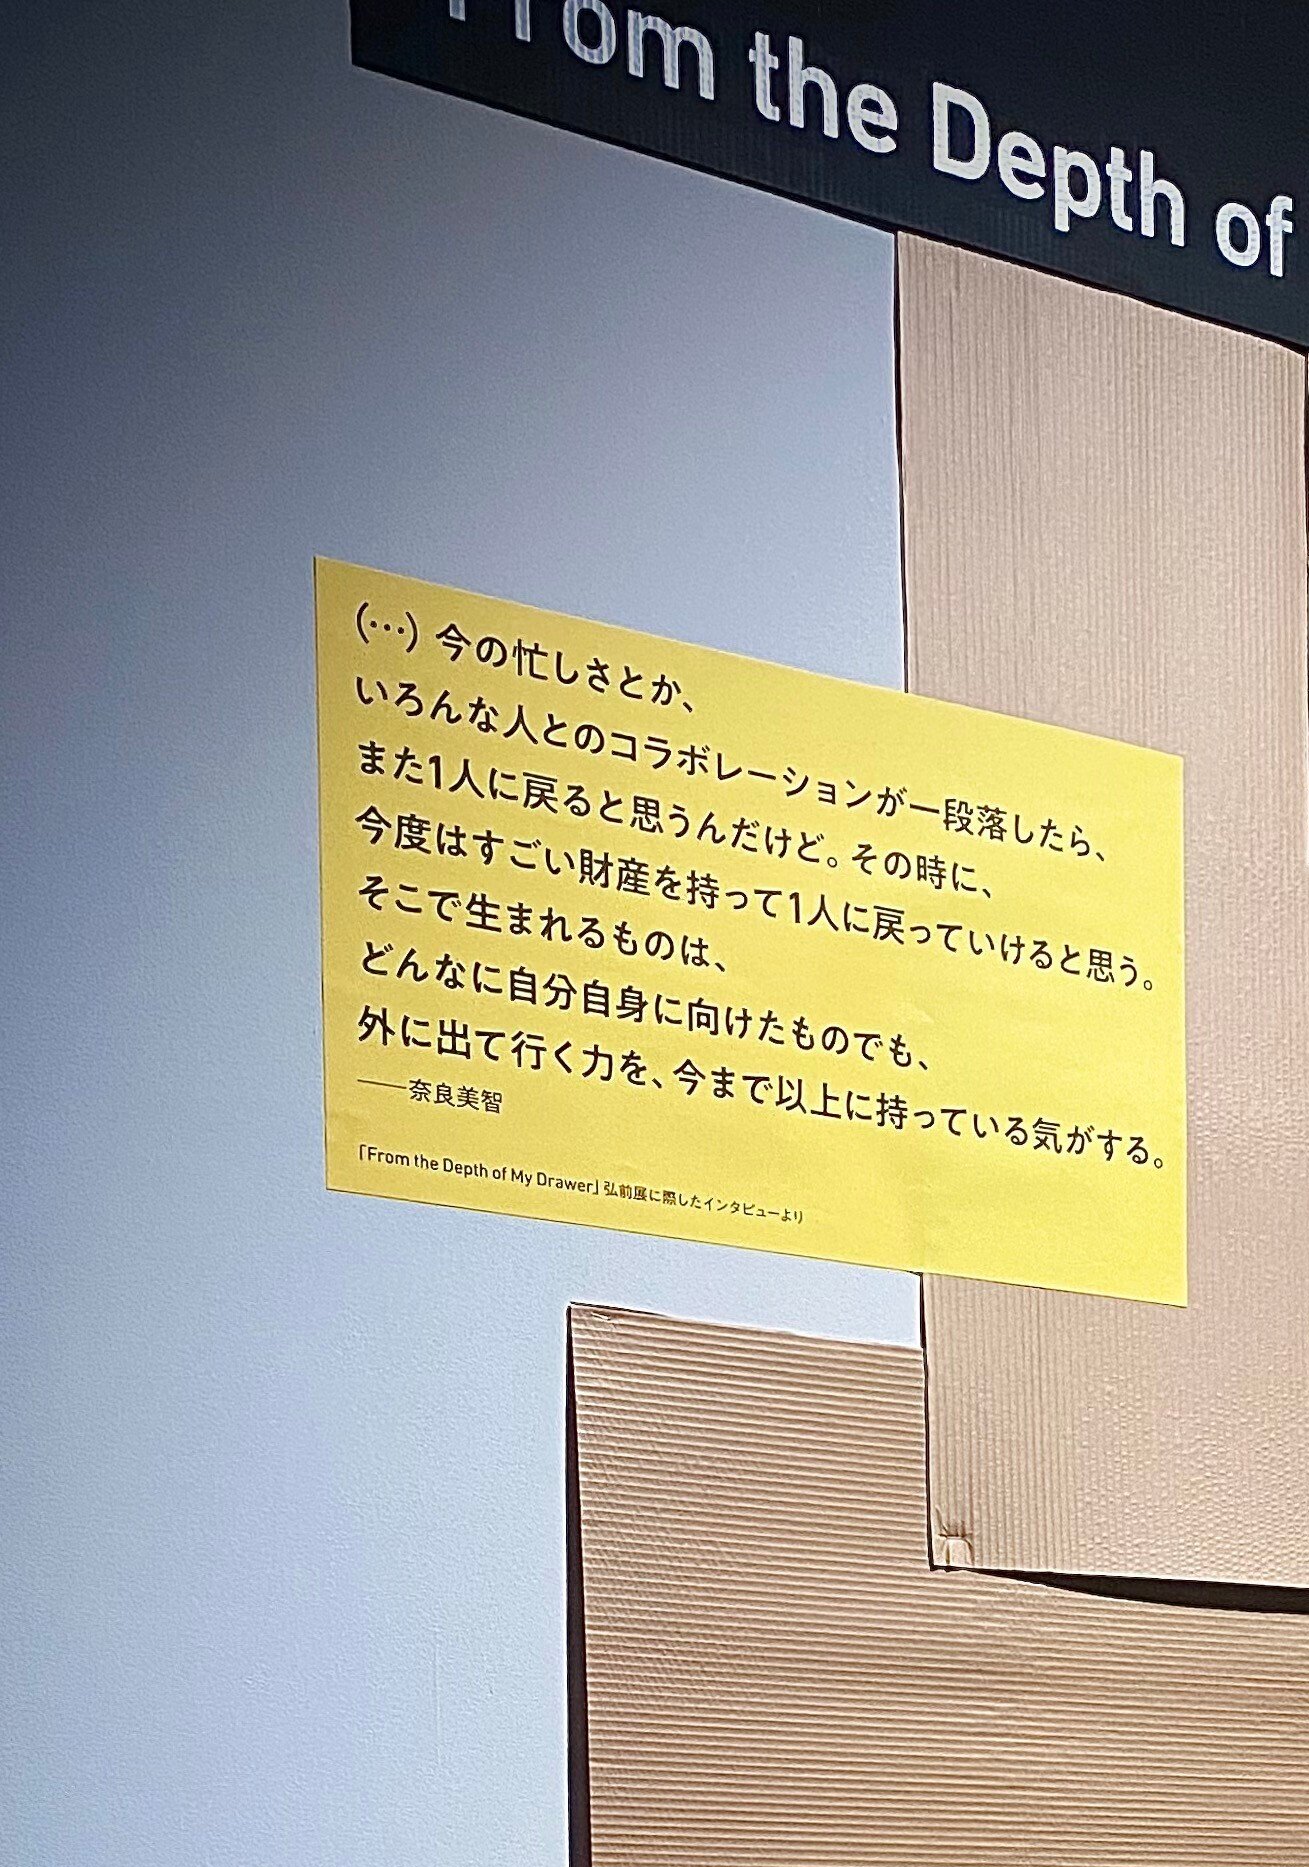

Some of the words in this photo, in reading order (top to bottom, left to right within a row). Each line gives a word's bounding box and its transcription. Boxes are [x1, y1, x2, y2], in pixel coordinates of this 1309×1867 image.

[449, 0, 714, 100] om
[749, 31, 898, 154] the
[932, 81, 1186, 246] Depth
[1216, 196, 1292, 277] of
[357, 677, 1106, 862] いろんな人とのコラボレーションが一段落したら、
[358, 876, 728, 972] そこで生まれるものは、
[361, 943, 931, 1070] どんなに自分自身に向けたものでも、
[358, 1006, 1165, 1168] 外に出て行く力を、今まで以上に持っている気がする。
[414, 1155, 439, 1170] the
[443, 1158, 488, 1178] Depth
[493, 1166, 507, 1180] of
[511, 1168, 532, 1187] My
